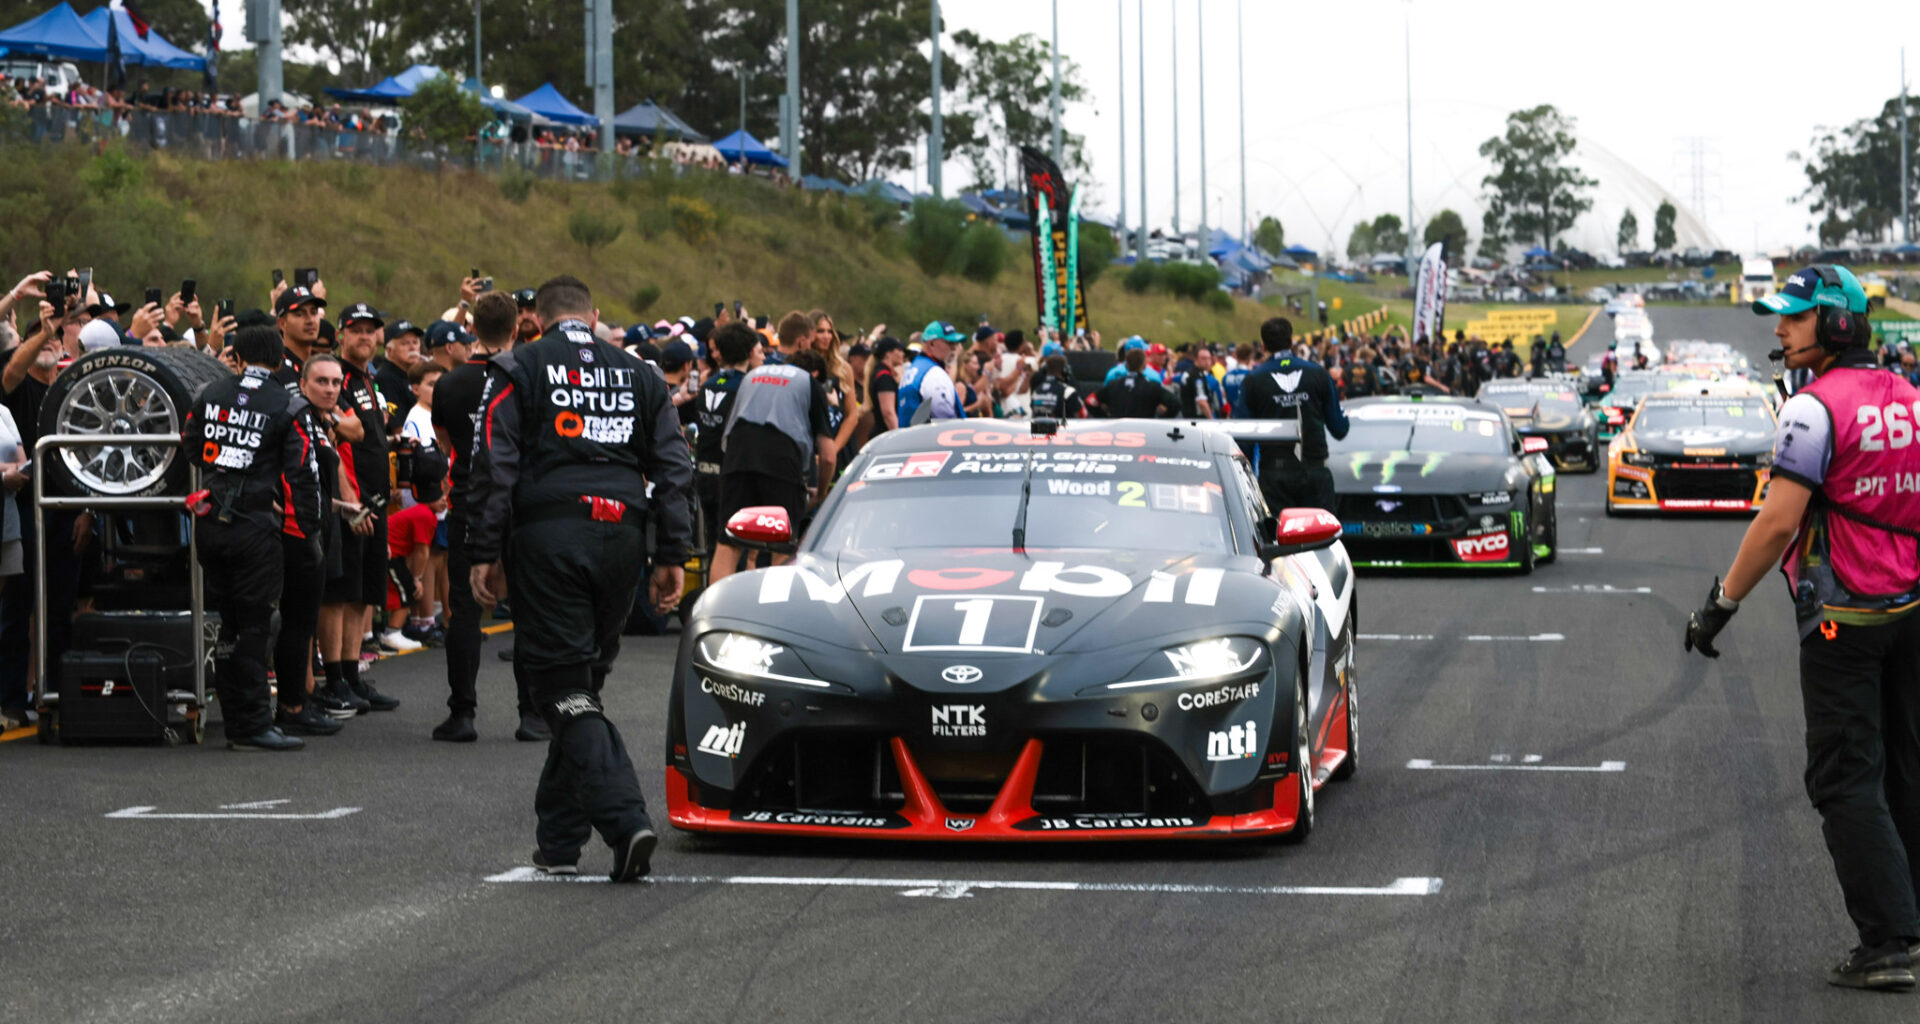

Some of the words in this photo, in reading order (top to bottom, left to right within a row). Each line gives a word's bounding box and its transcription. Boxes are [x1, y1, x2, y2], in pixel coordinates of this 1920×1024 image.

[82, 355, 158, 374] DUNLOP
[547, 364, 606, 388] Mobil
[752, 376, 790, 387] HOST
[551, 388, 635, 412] OPTUS
[205, 403, 248, 427] Mobil
[583, 415, 635, 430] TRUCK
[204, 423, 262, 448] OPTUS
[1857, 401, 1920, 451] 26
[581, 428, 633, 444] ASSIST
[936, 429, 1146, 447] Coates
[220, 445, 256, 461] TRUCK
[1138, 454, 1212, 470] Racing
[866, 460, 941, 478] GR
[951, 460, 1117, 474] Australia
[1048, 479, 1111, 496] Wood
[1854, 476, 1887, 496] PIT
[1895, 472, 1920, 494] LA
[1117, 481, 1147, 507] 2
[756, 514, 786, 531] BOC
[1457, 534, 1508, 555] RYCO
[759, 559, 1226, 606] Mobil
[954, 599, 994, 645] 1
[1164, 637, 1241, 674] NK
[102, 680, 114, 696] 2
[931, 704, 986, 725] NTK
[700, 721, 746, 755] nti
[932, 725, 986, 736] FILTERS
[1207, 720, 1257, 756] nti
[742, 811, 772, 821] JB
[776, 812, 887, 827] Caravans
[1041, 818, 1070, 829] JB
[1076, 817, 1193, 829] Caravans
